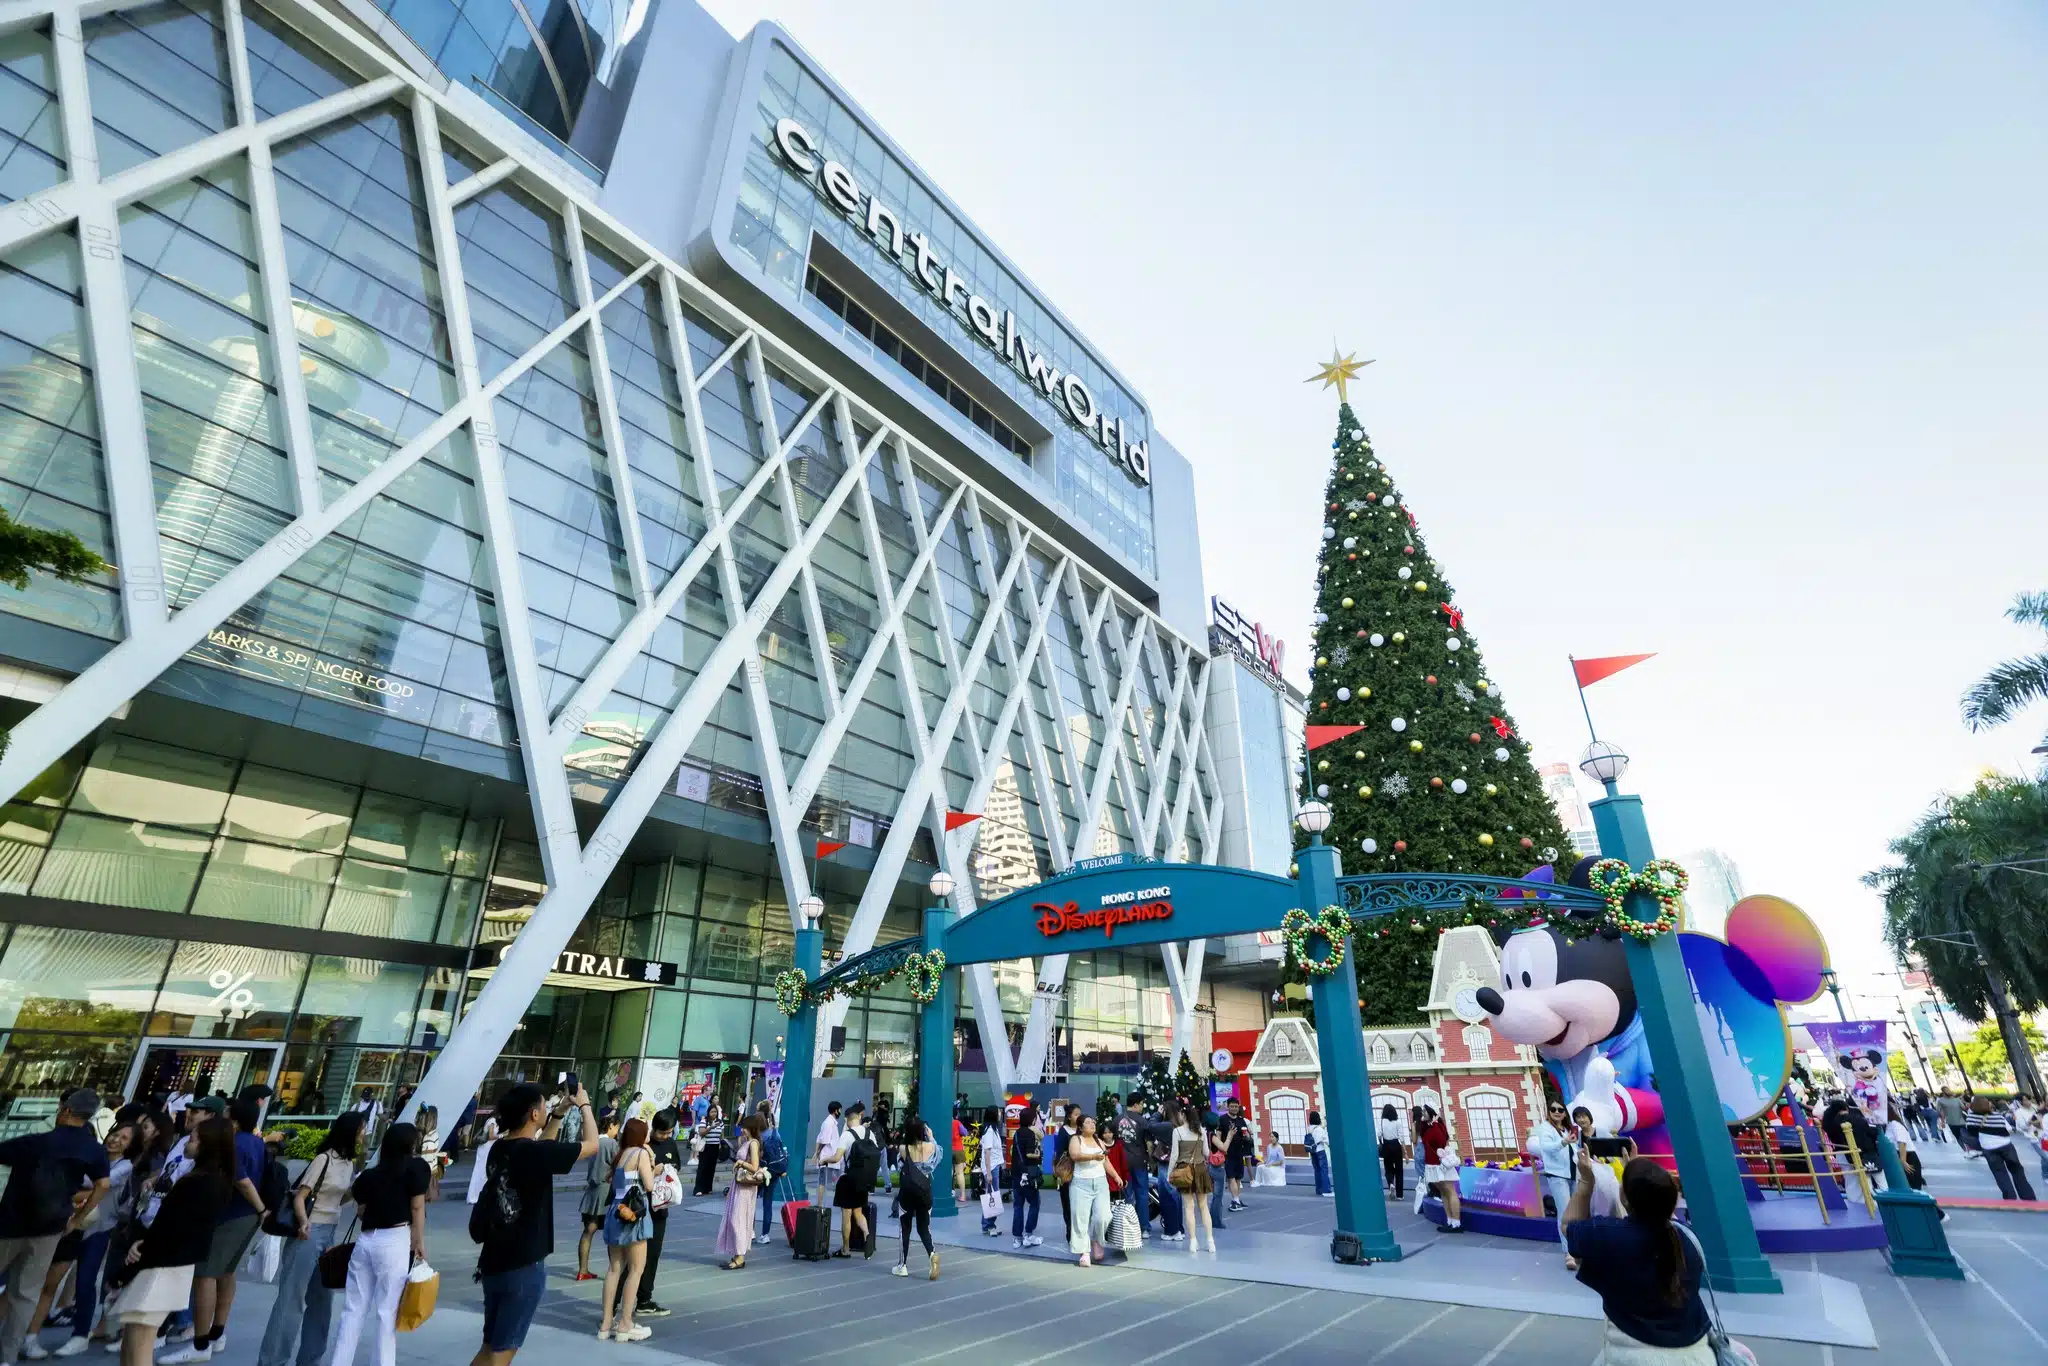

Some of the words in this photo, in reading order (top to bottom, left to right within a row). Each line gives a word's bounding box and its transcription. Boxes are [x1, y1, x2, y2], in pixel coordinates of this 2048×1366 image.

[266, 645, 279, 659] &
[366, 675, 414, 698] FOOD
[1081, 855, 1123, 870] WELCOME
[1101, 891, 1135, 905] HONG
[1137, 886, 1171, 901] KONG
[873, 1049, 900, 1061] KIKO
